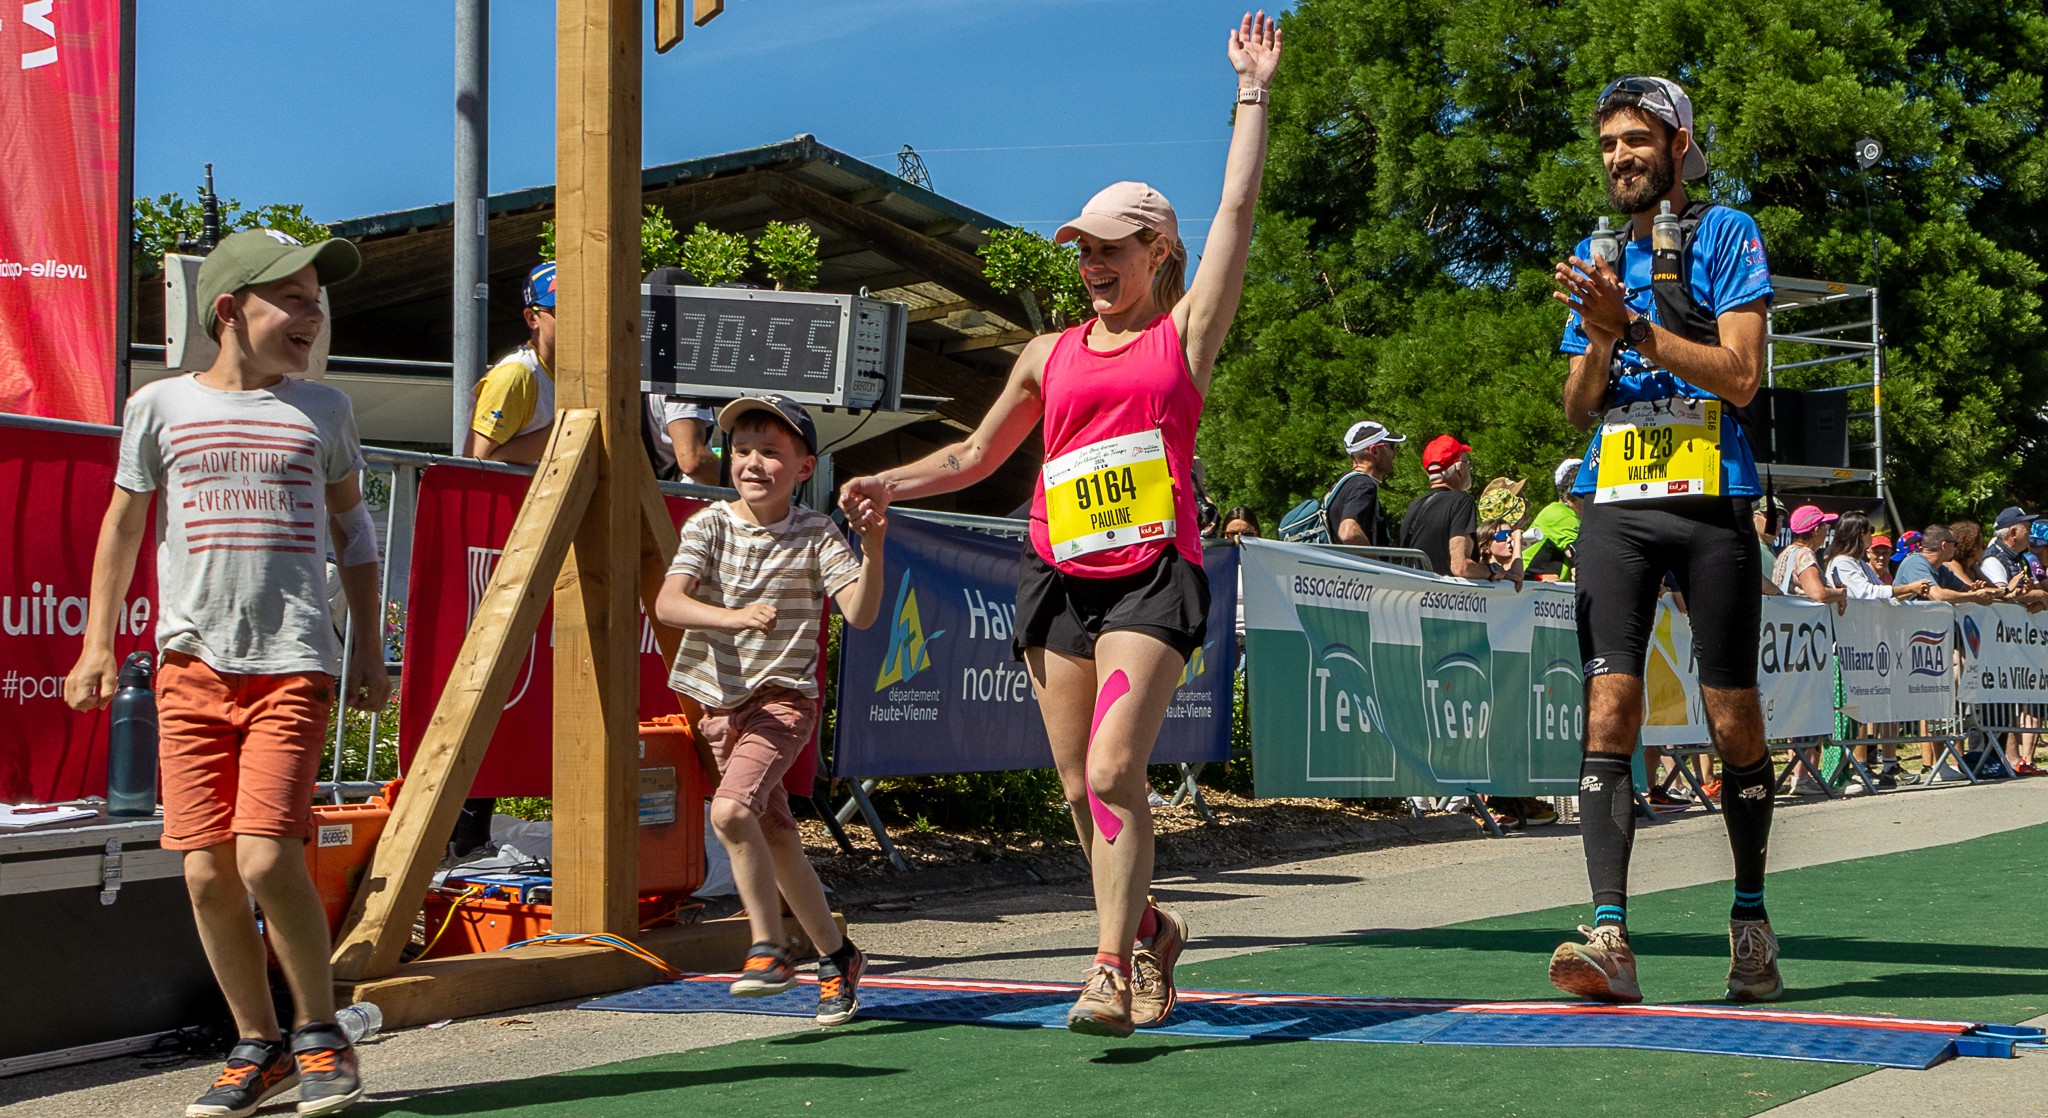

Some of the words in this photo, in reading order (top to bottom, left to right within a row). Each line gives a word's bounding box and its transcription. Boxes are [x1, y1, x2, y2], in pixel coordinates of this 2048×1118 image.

[1707, 410, 1717, 430] 9123
[1623, 427, 1673, 461] 9123
[201, 451, 288, 474] ADVENTURE
[1628, 463, 1667, 481] VALENTIN
[1075, 467, 1137, 510] 9164
[198, 489, 296, 512] EVERYWHERE
[1090, 506, 1133, 530] PAULINE
[1294, 575, 1373, 601] association
[1420, 591, 1487, 613] association
[1534, 598, 1577, 621] associat
[1996, 619, 2022, 644] Avec
[2025, 622, 2038, 645] le
[1838, 646, 1875, 671] Allianz
[1911, 645, 1944, 671] MAA
[962, 661, 1028, 703] notre
[1982, 666, 1995, 690] de
[1998, 666, 2008, 690] la
[2009, 666, 2037, 690] Ville
[889, 686, 941, 704] département
[1176, 689, 1212, 703] département
[869, 703, 938, 722] Haute-Vienne
